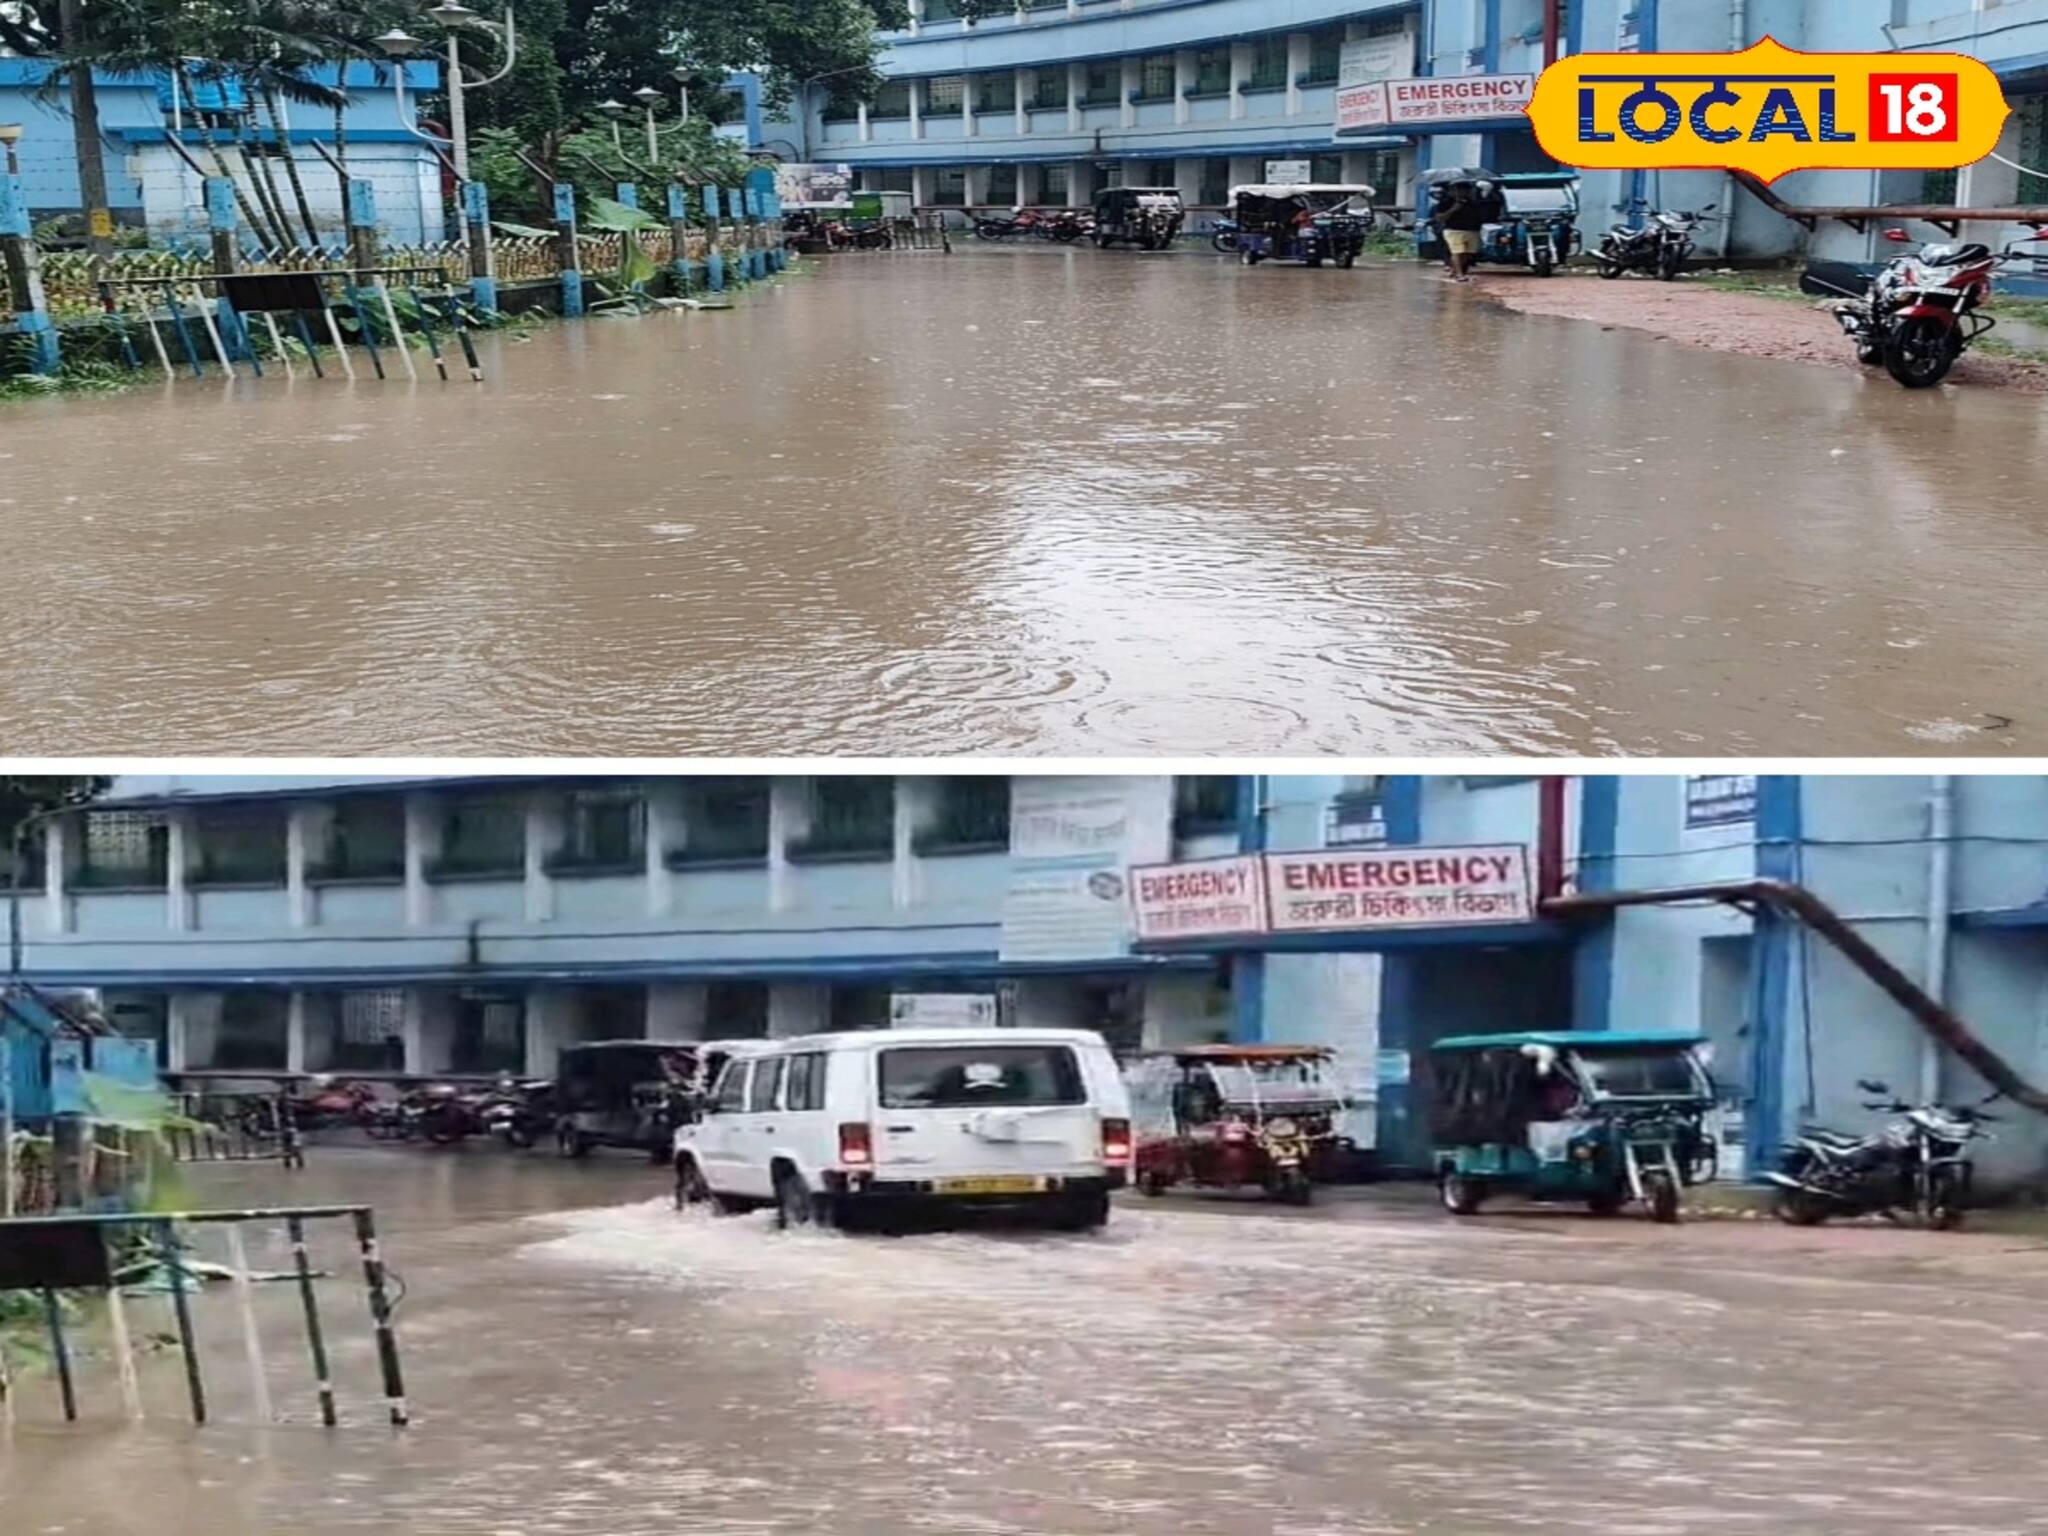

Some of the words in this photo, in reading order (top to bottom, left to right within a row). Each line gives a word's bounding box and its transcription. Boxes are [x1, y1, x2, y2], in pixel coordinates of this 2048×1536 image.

[1396, 80, 1527, 101] EMERGENCY
[1141, 867, 1248, 902] EMERGENCY
[1283, 856, 1512, 891] EMERGENCY
